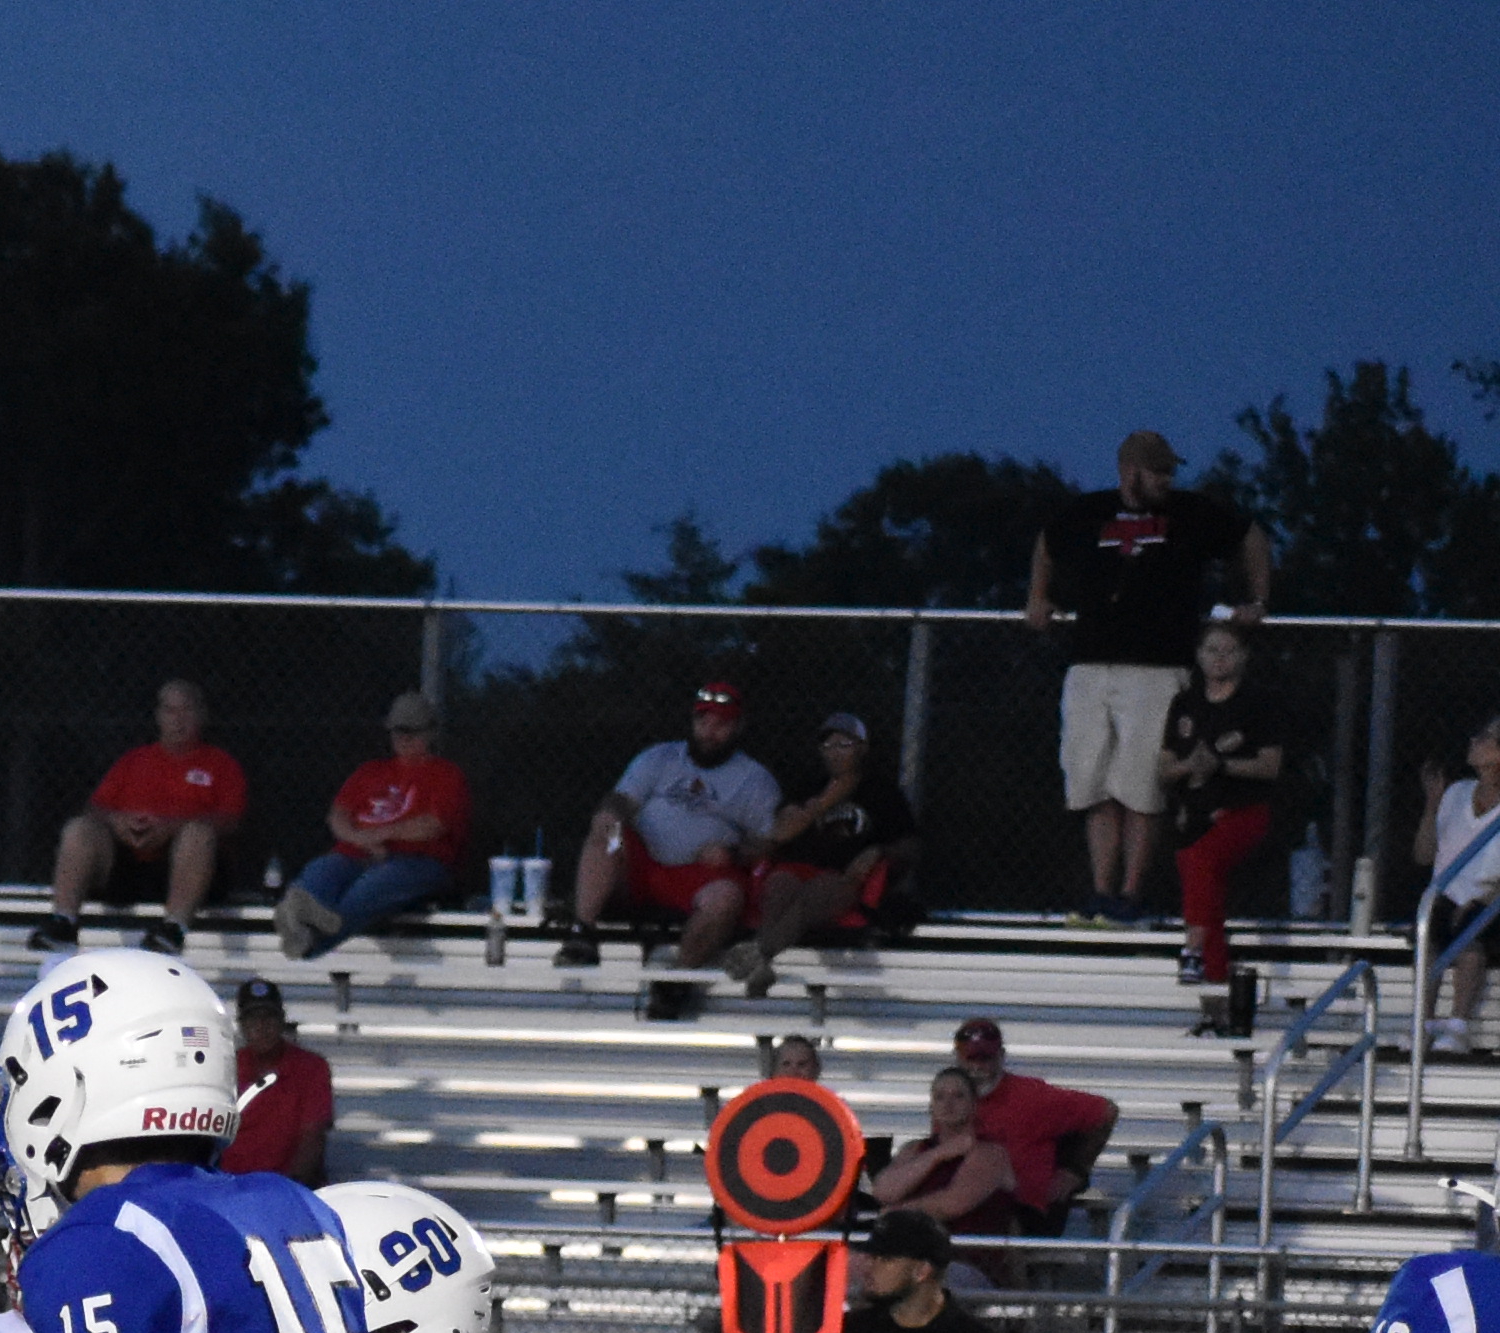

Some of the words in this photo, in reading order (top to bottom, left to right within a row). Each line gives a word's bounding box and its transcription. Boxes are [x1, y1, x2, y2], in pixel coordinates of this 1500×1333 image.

[28, 980, 92, 1061] 15
[142, 1106, 238, 1135] Riddell
[379, 1218, 462, 1293] 80
